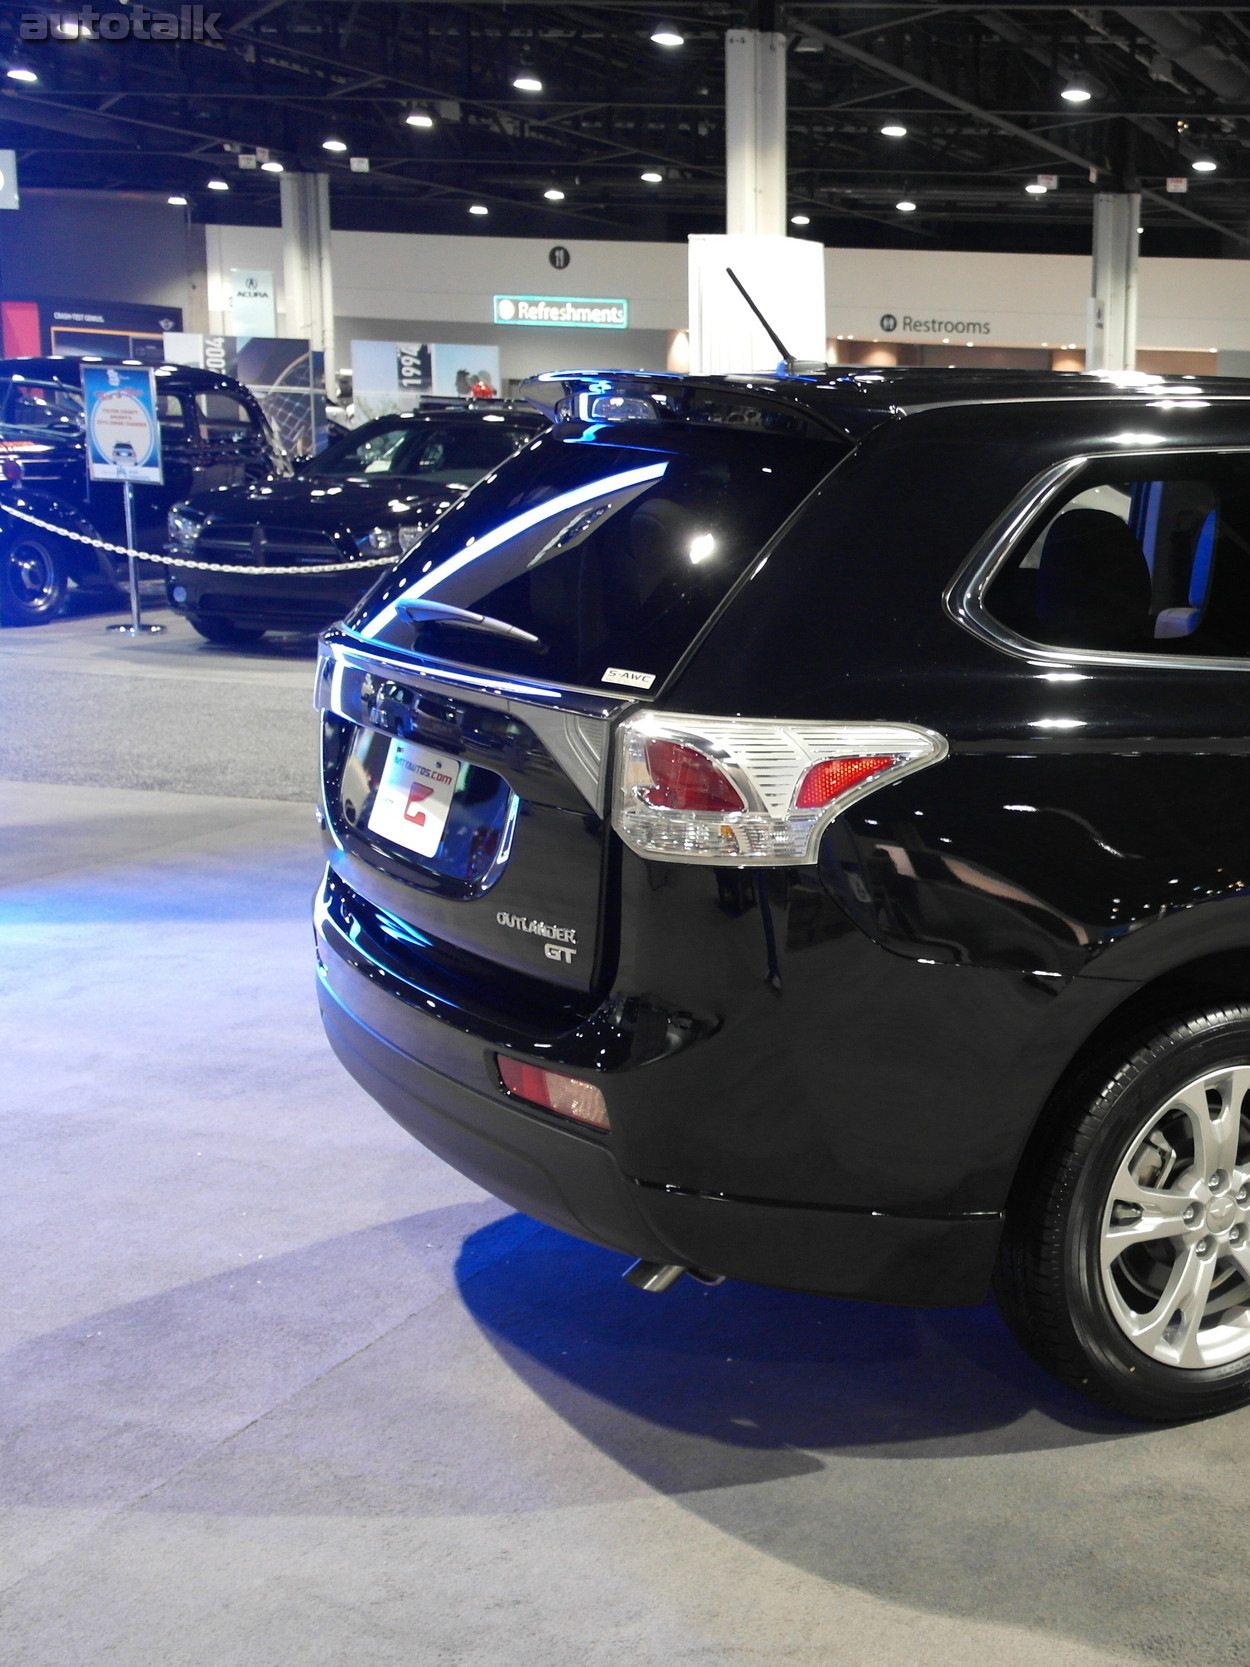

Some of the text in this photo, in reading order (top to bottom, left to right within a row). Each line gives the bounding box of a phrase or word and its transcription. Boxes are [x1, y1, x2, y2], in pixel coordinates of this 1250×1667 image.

[517, 301, 625, 323] Refreshments
[902, 316, 991, 335] Restrooms
[608, 670, 651, 683] S-AWC
[496, 911, 576, 944] OUTLANDER
[544, 943, 577, 964] GT
